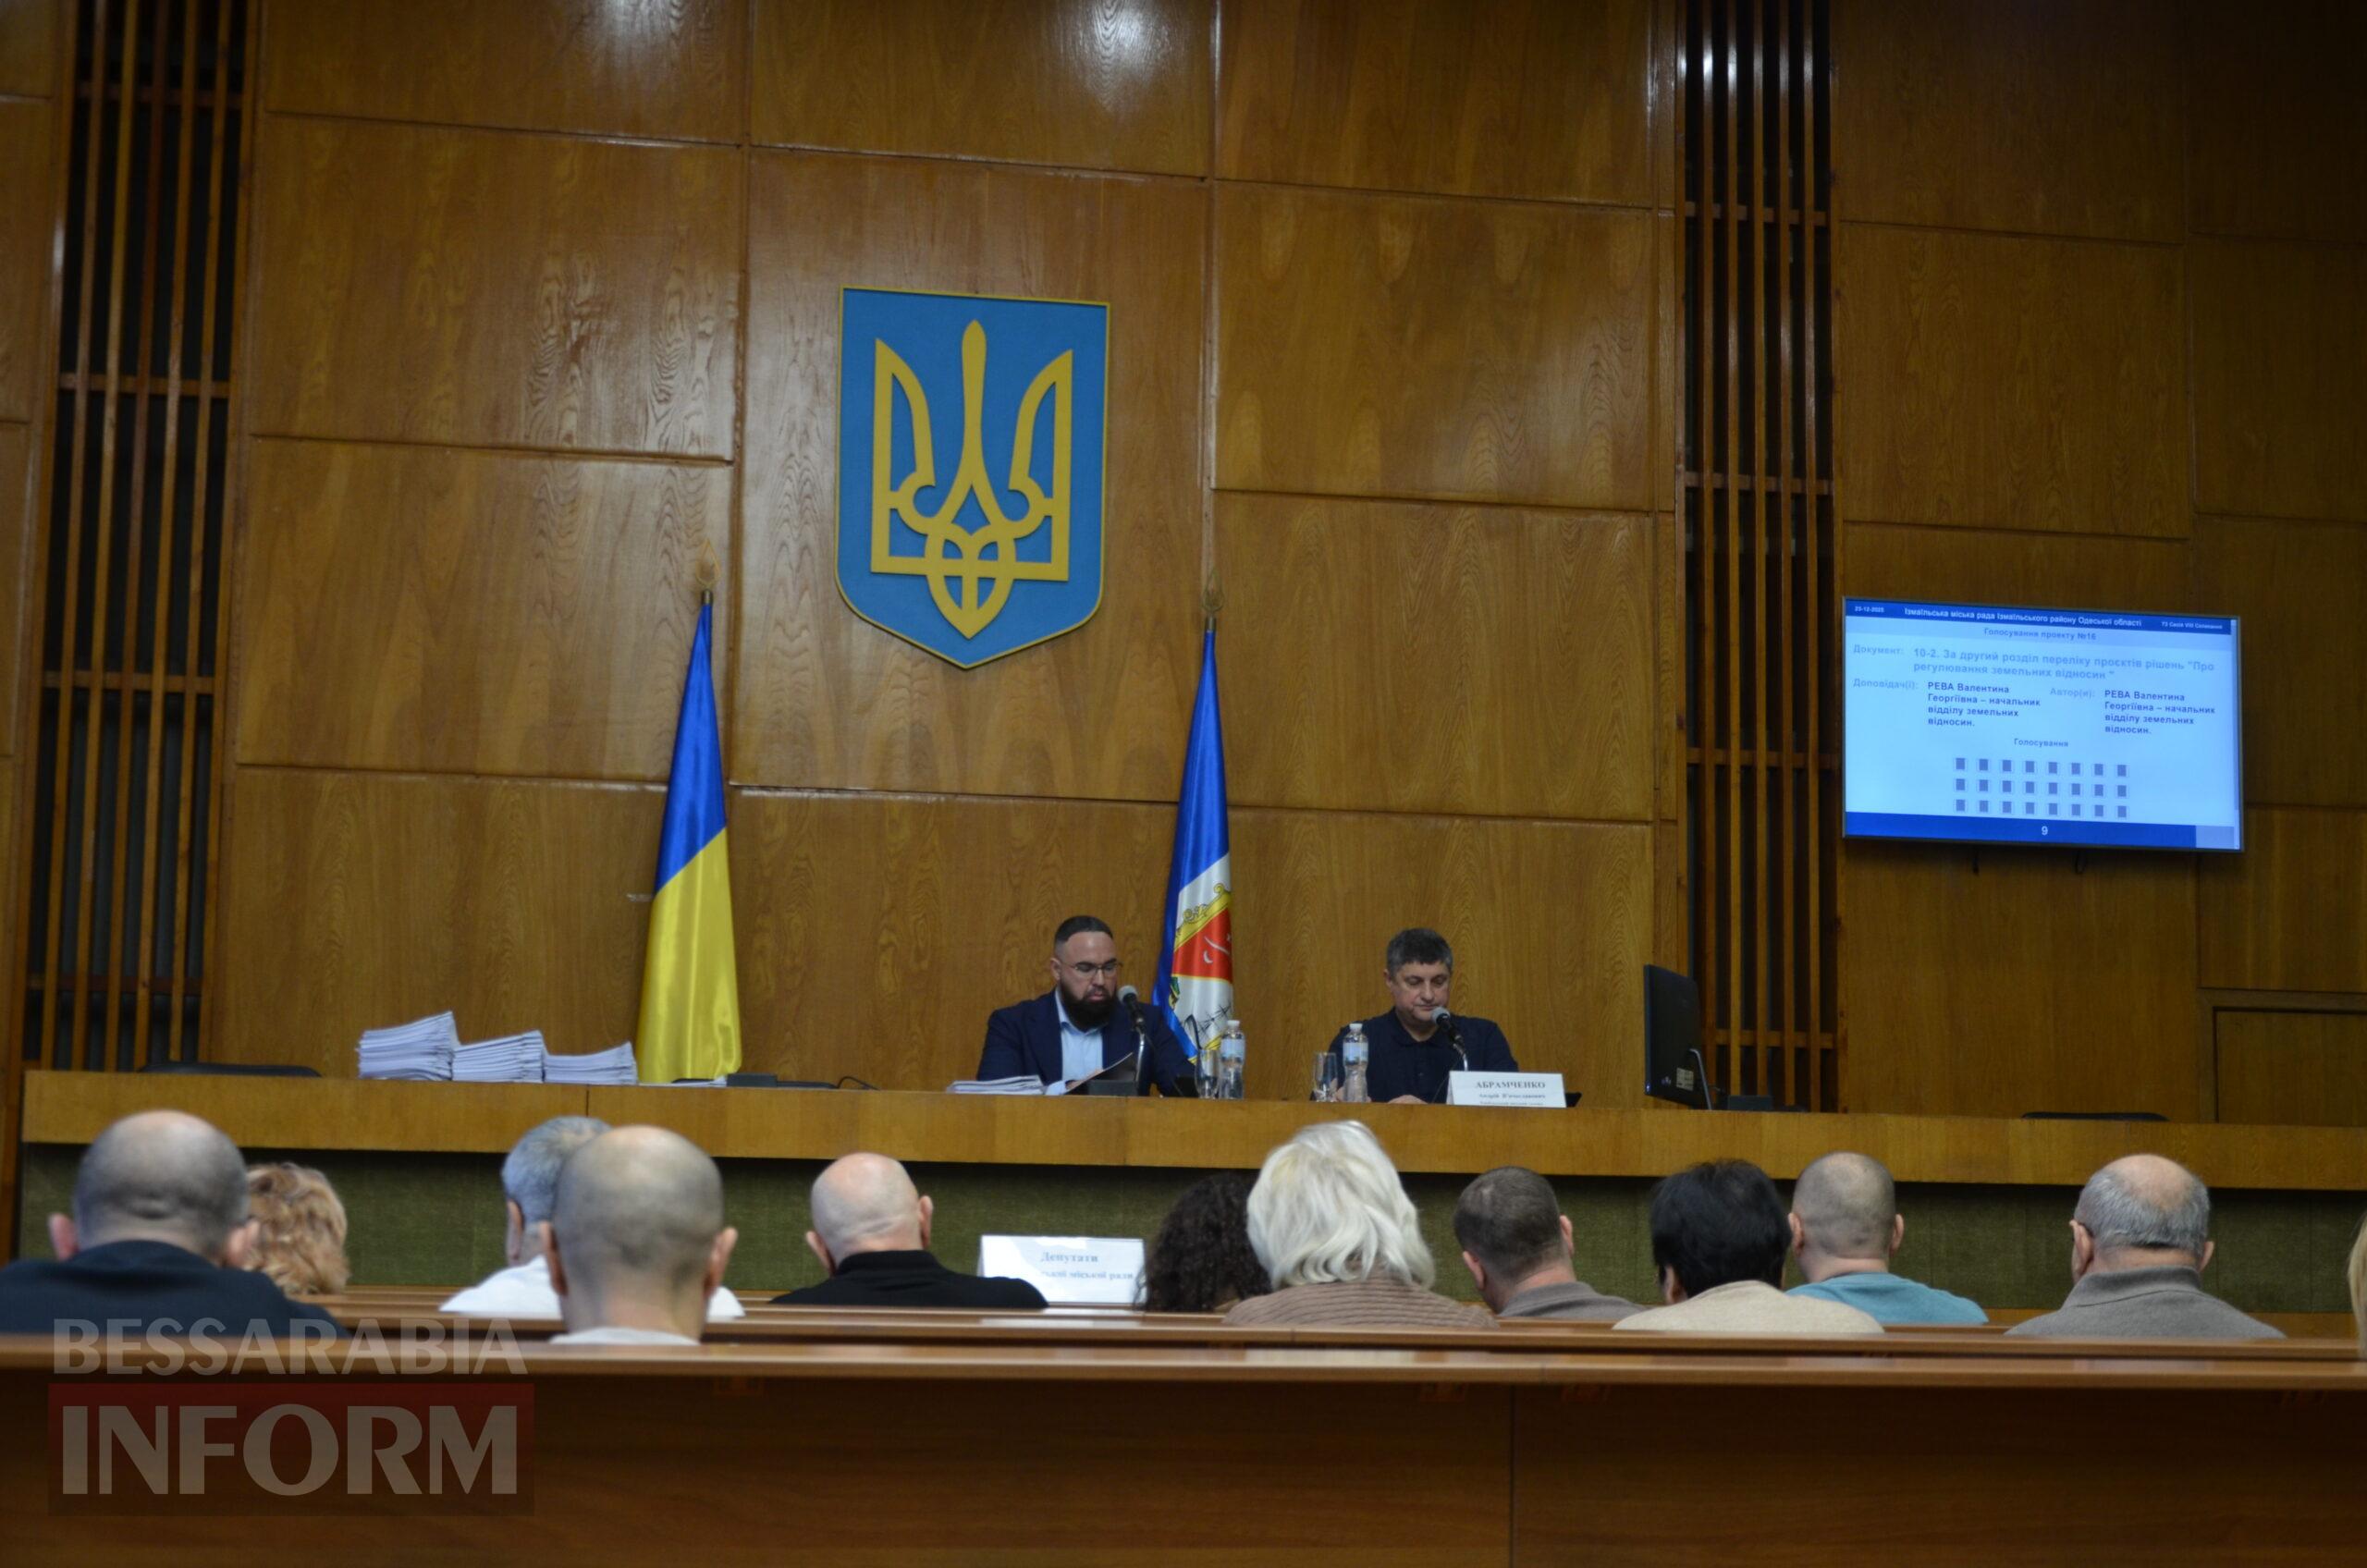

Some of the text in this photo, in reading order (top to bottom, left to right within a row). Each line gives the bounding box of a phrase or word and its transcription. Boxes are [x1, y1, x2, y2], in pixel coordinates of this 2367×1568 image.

[1905, 607, 2142, 628] Ізмаїльська міська рада Ізмаїльського району Одеської області
[1984, 628, 2039, 638] Голосування
[1854, 644, 1904, 655] Документ:
[1914, 648, 1939, 658] 10-2.
[1944, 649, 1956, 659] За
[1960, 651, 1999, 663] другий
[2002, 653, 2039, 664] розділ
[2042, 655, 2091, 667] переліку
[2145, 658, 2185, 670] рішень
[2188, 660, 2215, 672] "Про
[1914, 663, 1988, 674] регулювання
[1992, 667, 2052, 677] земельних
[2055, 668, 2105, 680] відносин
[1928, 681, 2010, 693] РЕВА Валентина
[1928, 693, 1978, 705] Георгіївна
[1989, 698, 2041, 707] начальник
[2104, 690, 2185, 702] РЕВА Валентина
[1928, 705, 2018, 717] відділу земельних
[2104, 701, 2154, 713] Георгіївна
[2165, 705, 2215, 715] начальник
[1928, 717, 1975, 728] відносин.
[2104, 714, 2194, 725] відділу земельних
[2104, 725, 2152, 735] відносин.
[2014, 738, 2068, 748] Голосування
[2041, 826, 2048, 836] 9
[1476, 1081, 1546, 1089] АБРАМЧЕНКО
[1040, 1252, 1098, 1264] Депутати
[1109, 1272, 1134, 1280] ради
